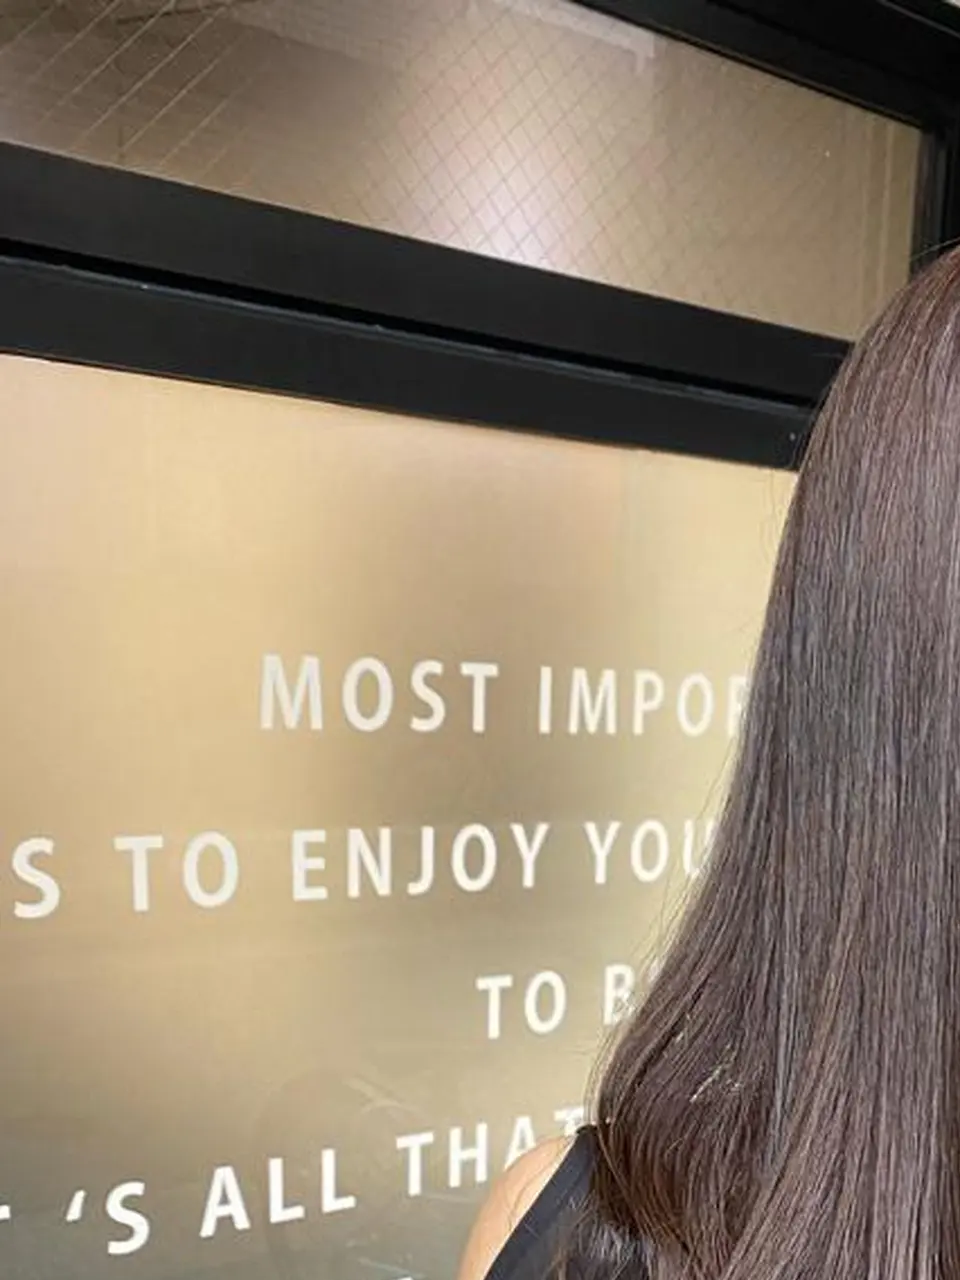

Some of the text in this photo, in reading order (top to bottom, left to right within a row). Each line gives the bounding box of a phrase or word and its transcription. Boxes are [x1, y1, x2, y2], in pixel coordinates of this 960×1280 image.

[260, 655, 499, 733] MOST
[115, 832, 239, 912] TO
[292, 822, 549, 901] ENJOY
[476, 970, 567, 1040] TO
[200, 1148, 357, 1239] ALL
